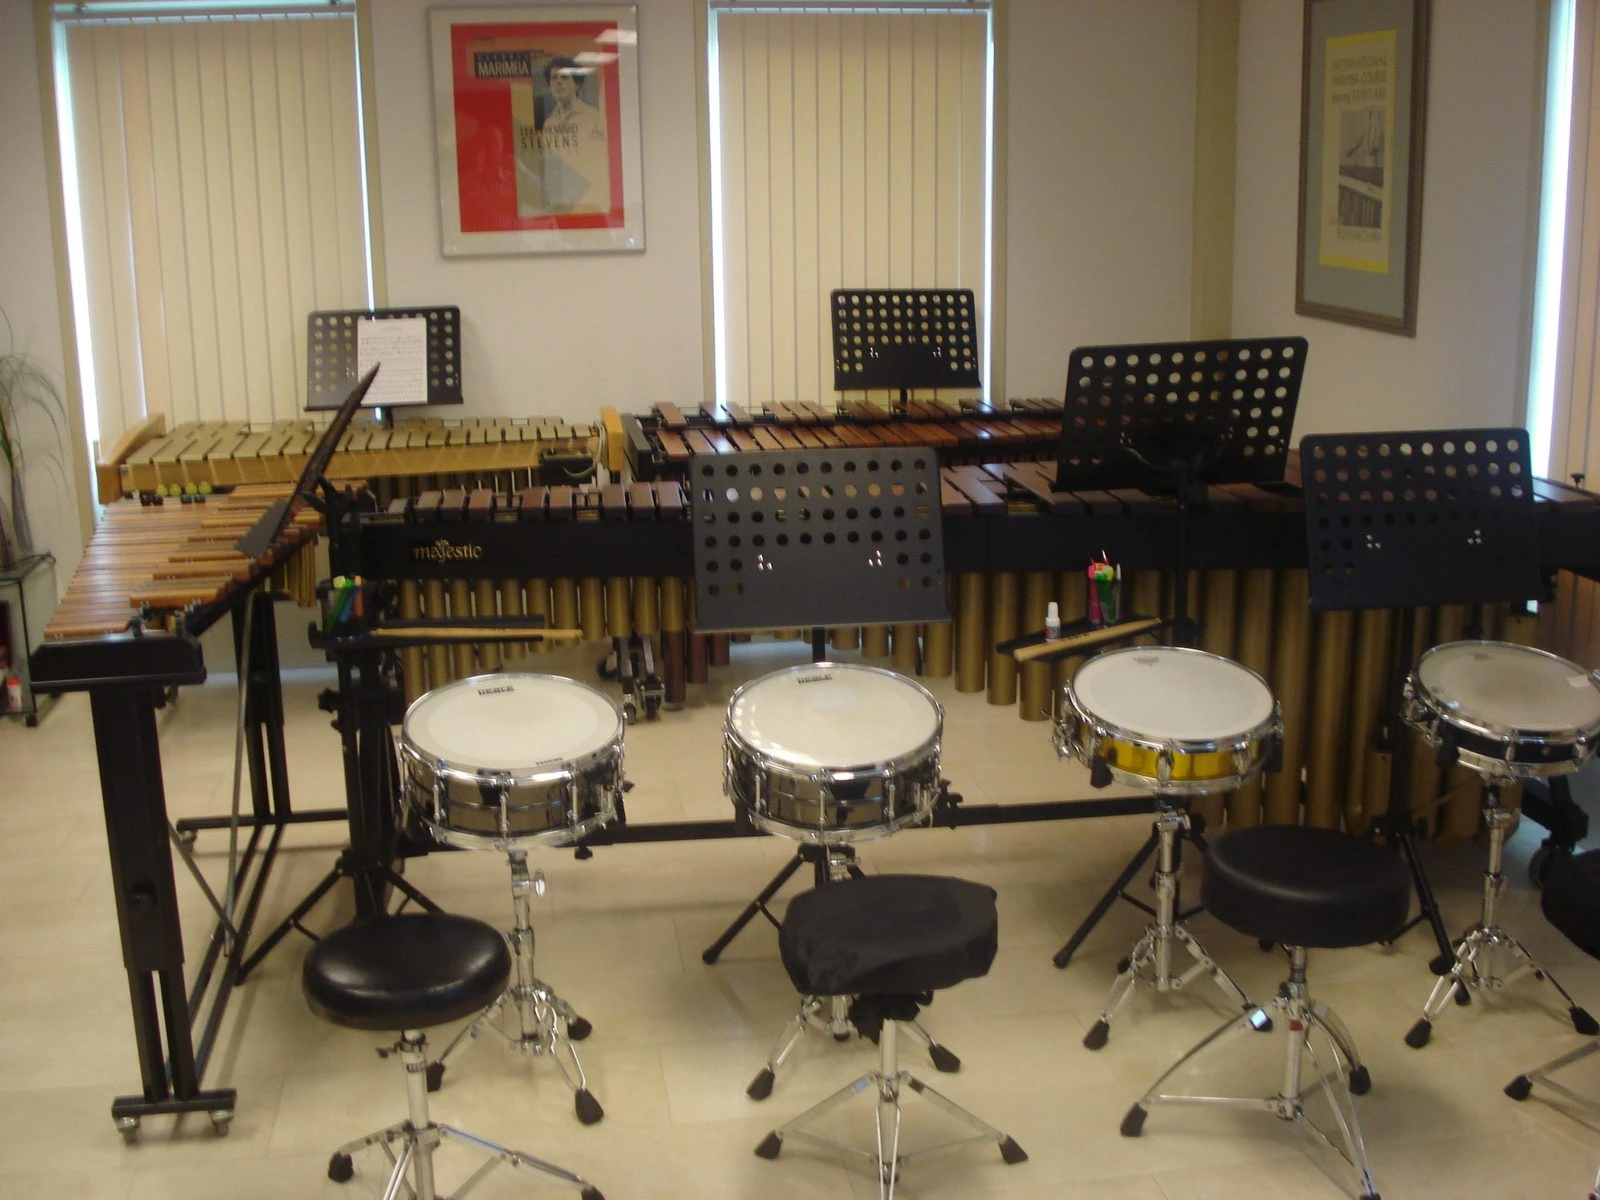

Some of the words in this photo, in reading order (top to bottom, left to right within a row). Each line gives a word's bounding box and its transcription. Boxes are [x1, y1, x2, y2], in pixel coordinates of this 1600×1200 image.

[478, 60, 529, 77] MARIMBA
[519, 136, 579, 150] STEVENS
[413, 542, 482, 564] majestic
